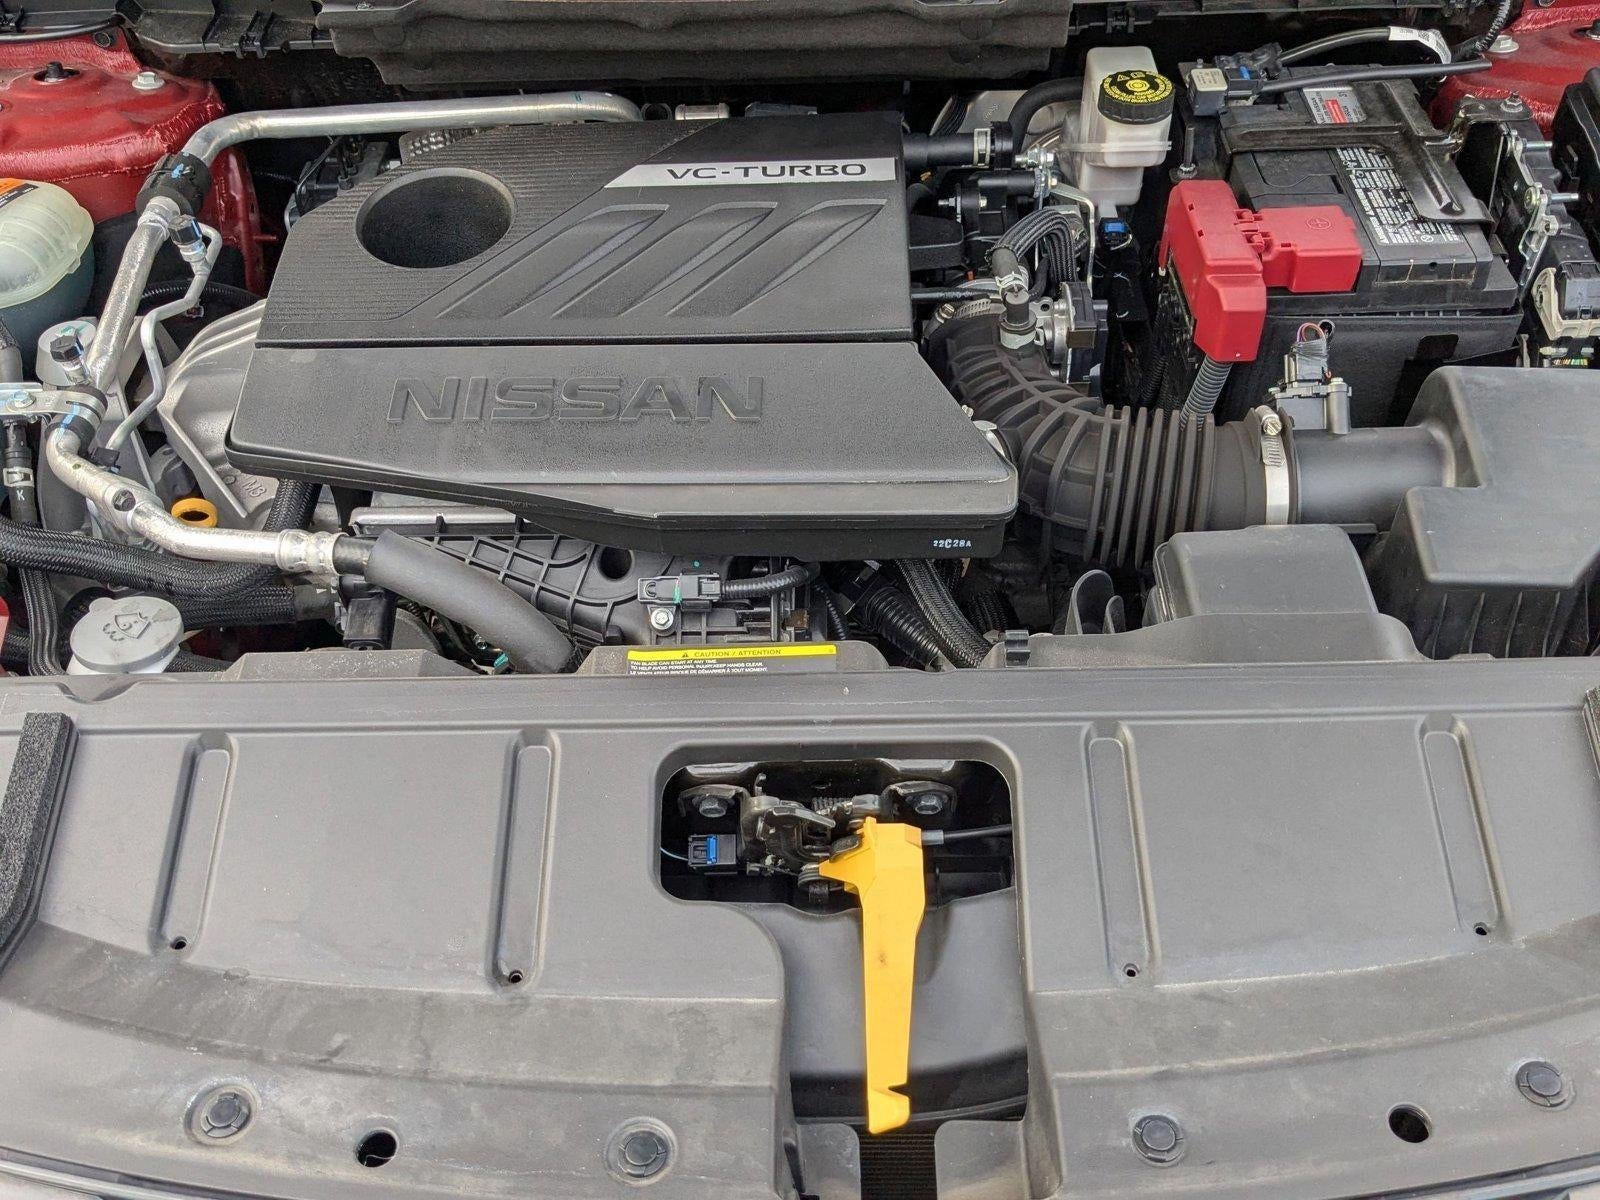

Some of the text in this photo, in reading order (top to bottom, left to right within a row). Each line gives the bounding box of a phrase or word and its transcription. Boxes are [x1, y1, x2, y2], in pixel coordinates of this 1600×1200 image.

[667, 163, 867, 180] VC-TURBO
[386, 376, 764, 424] NISSAN
[16, 489, 25, 501] K
[933, 538, 972, 549] 22C28A
